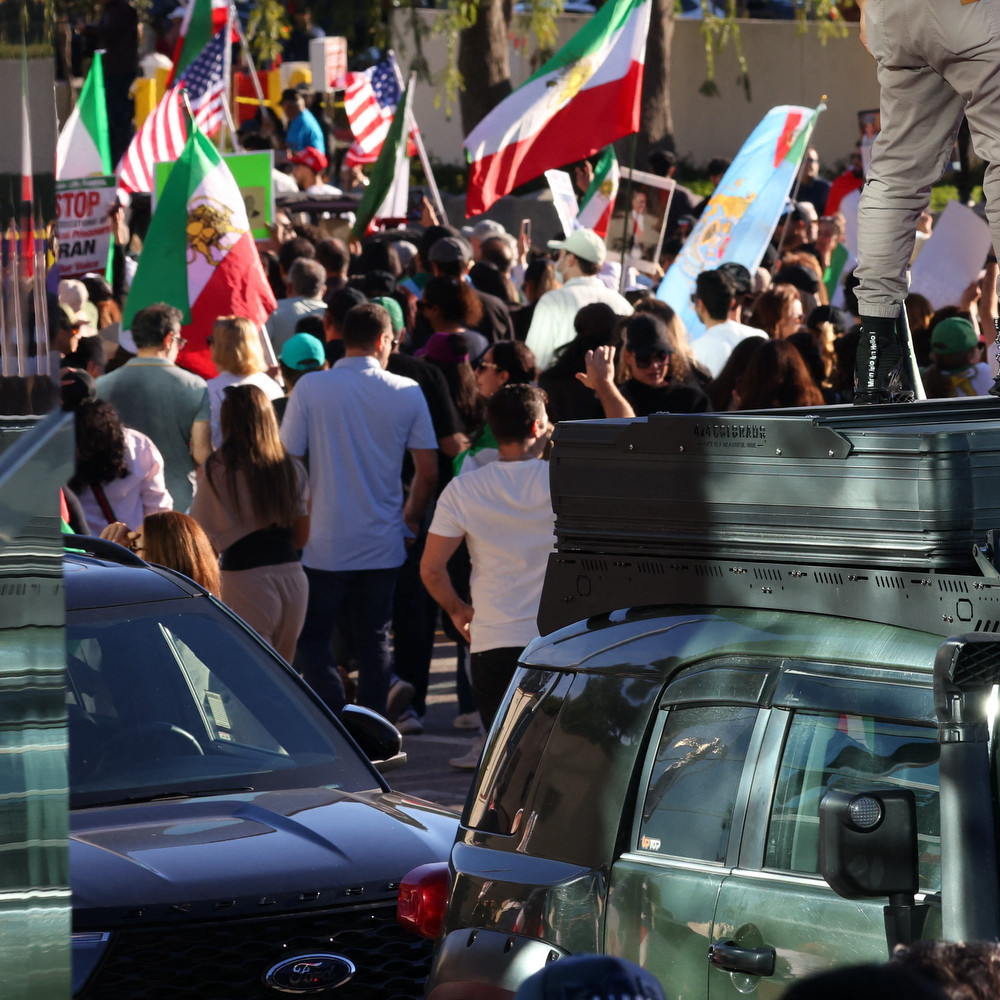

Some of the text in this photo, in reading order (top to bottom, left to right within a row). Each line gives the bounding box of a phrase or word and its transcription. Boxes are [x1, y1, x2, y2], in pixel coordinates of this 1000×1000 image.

[56, 191, 100, 218] STOP
[59, 239, 96, 259] RAN
[713, 425, 766, 439] COLORADO
